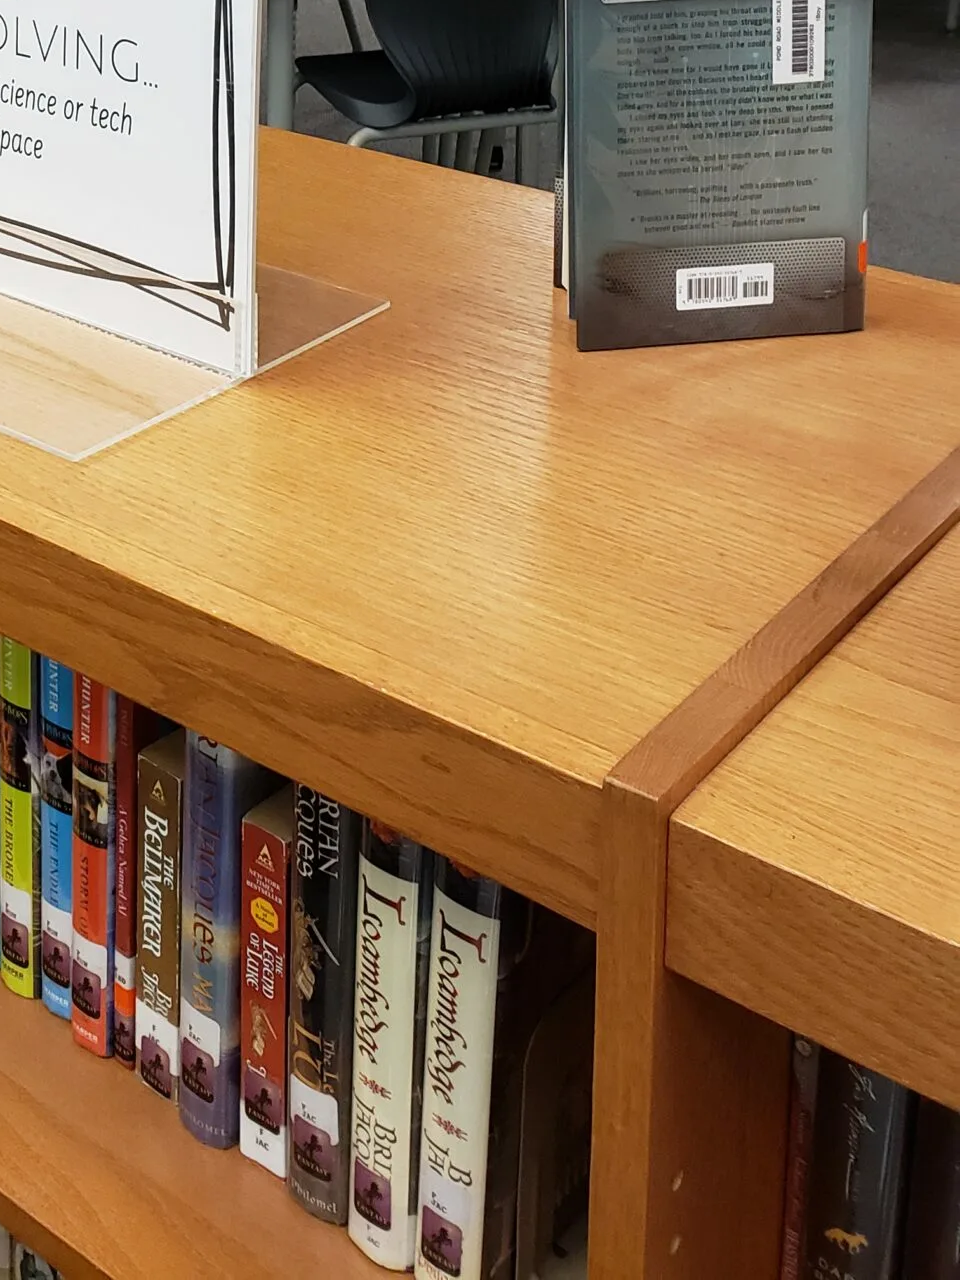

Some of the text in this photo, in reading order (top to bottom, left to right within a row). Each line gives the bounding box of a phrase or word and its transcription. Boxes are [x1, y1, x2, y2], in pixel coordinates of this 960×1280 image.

[63, 98, 83, 121] or
[90, 99, 132, 136] tech
[81, 675, 91, 745] HUNTER
[4, 798, 15, 887] THE BROKE
[318, 795, 340, 880] RIAN
[49, 821, 59, 908] THE ENDLE
[163, 855, 174, 891] THE
[258, 855, 272, 867] ACE
[80, 855, 89, 910] STORM
[117, 861, 128, 900] Named
[246, 880, 283, 906] BESTSELLER
[263, 876, 281, 891] YORK
[1, 960, 24, 980] HARPER
[246, 932, 263, 992] OF LUKE
[262, 938, 278, 1000] LEGEND
[276, 953, 285, 978] THE
[355, 873, 406, 1066] Loamhedge
[427, 907, 487, 1106] Loamhedge
[323, 1039, 336, 1068] The
[247, 1105, 280, 1136] FANTASY
[259, 1128, 264, 1136] F
[302, 1110, 316, 1123] JAC
[353, 1087, 375, 1166] JACQ
[255, 1138, 270, 1151] JAC
[373, 1118, 397, 1176] BRI
[297, 1153, 328, 1178] FANTASY
[357, 1201, 388, 1226] FANTASY
[431, 1198, 447, 1214] JAC
[367, 1235, 380, 1248] JAC
[423, 1245, 457, 1271] FANTASY
